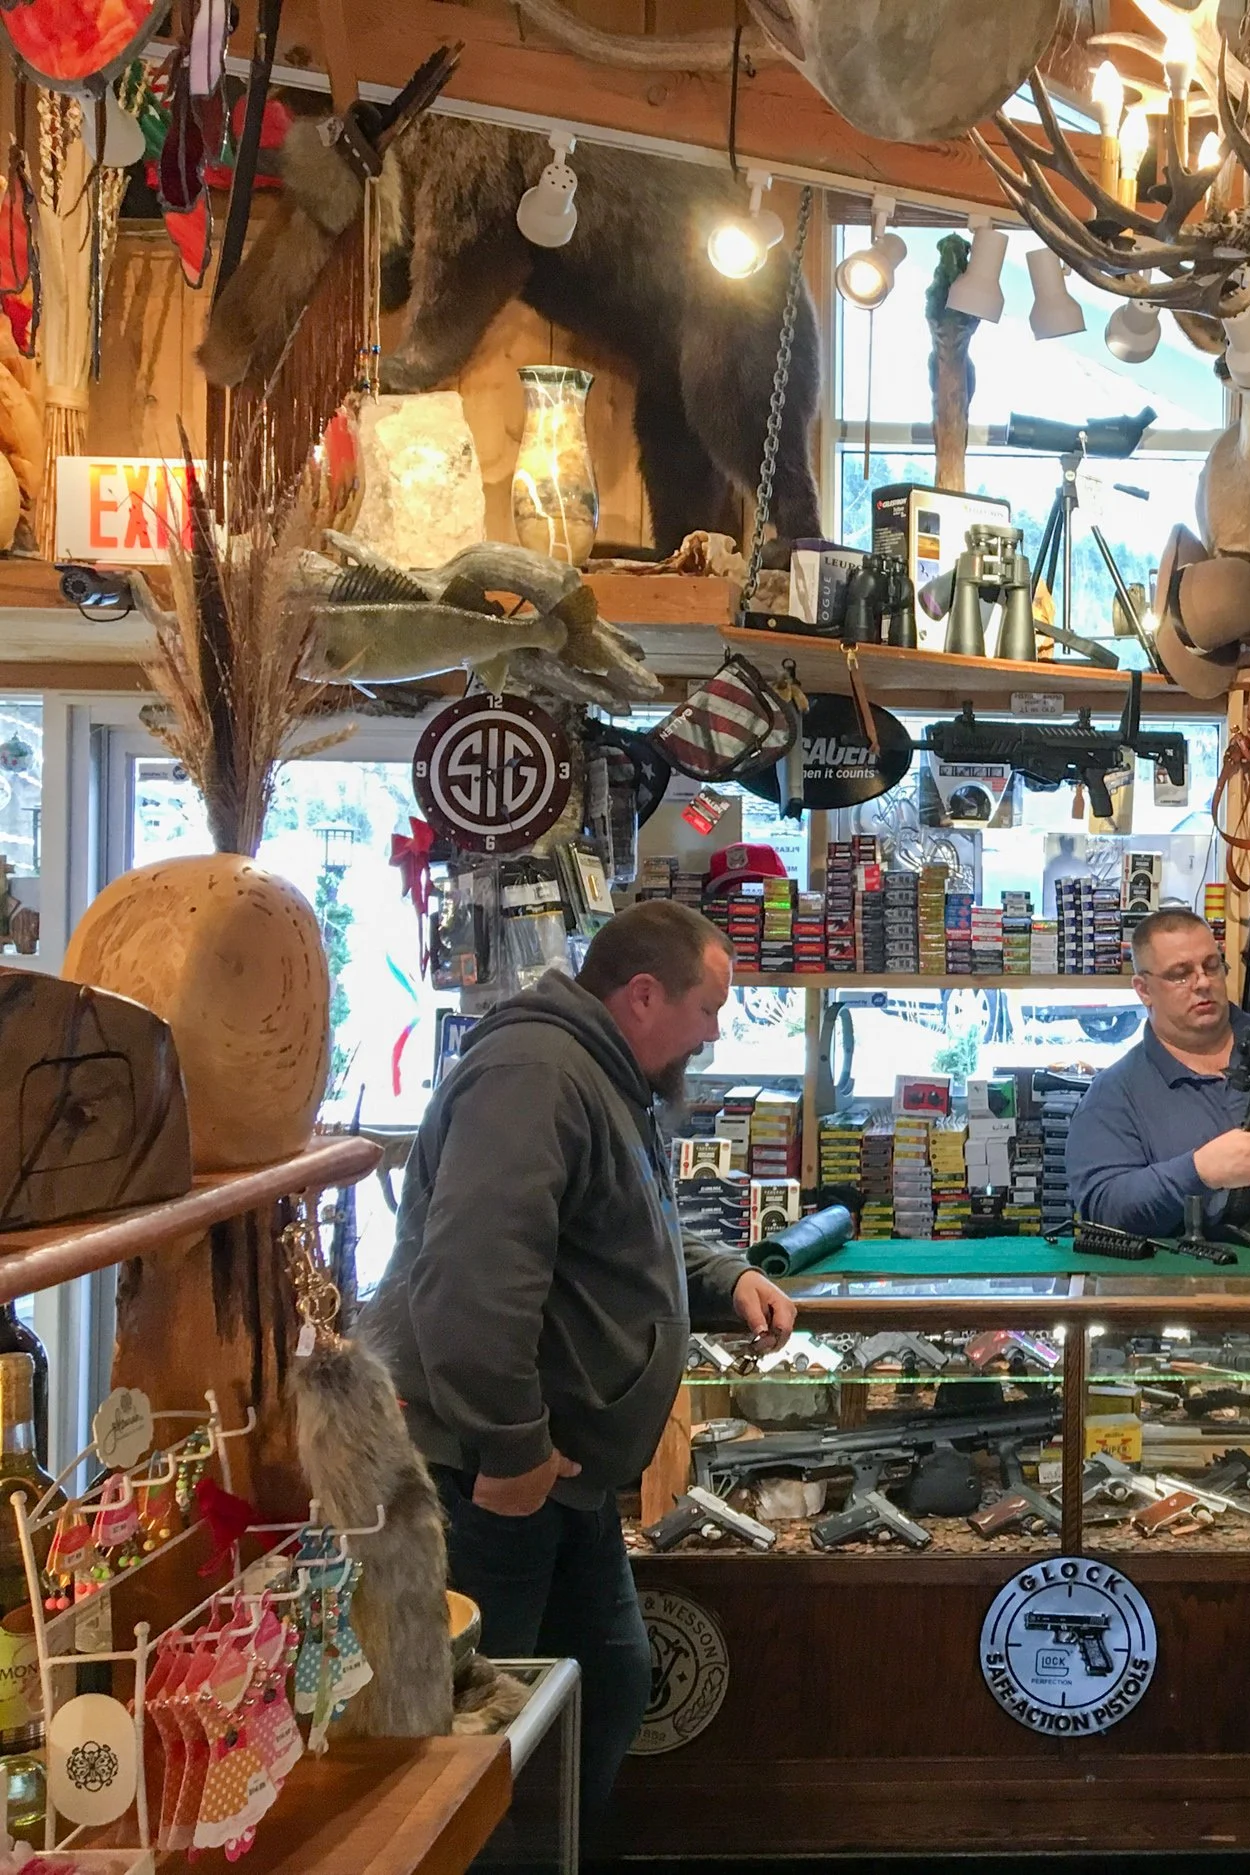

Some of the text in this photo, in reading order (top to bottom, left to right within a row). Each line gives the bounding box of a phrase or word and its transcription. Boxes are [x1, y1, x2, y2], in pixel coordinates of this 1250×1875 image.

[88, 464, 202, 550] EXIT
[821, 576, 833, 621] OGUE
[486, 695, 503, 708] 12
[416, 761, 427, 778] 9
[448, 727, 538, 818] SIG
[559, 762, 570, 779] 3
[824, 767, 834, 779] it
[836, 768, 875, 779] counts
[485, 836, 496, 850] 6
[1020, 1562, 1125, 1595] GLOCK
[644, 1598, 718, 1659] & WESSON
[986, 1652, 1149, 1732] SAFE-ACTION PISTOLS
